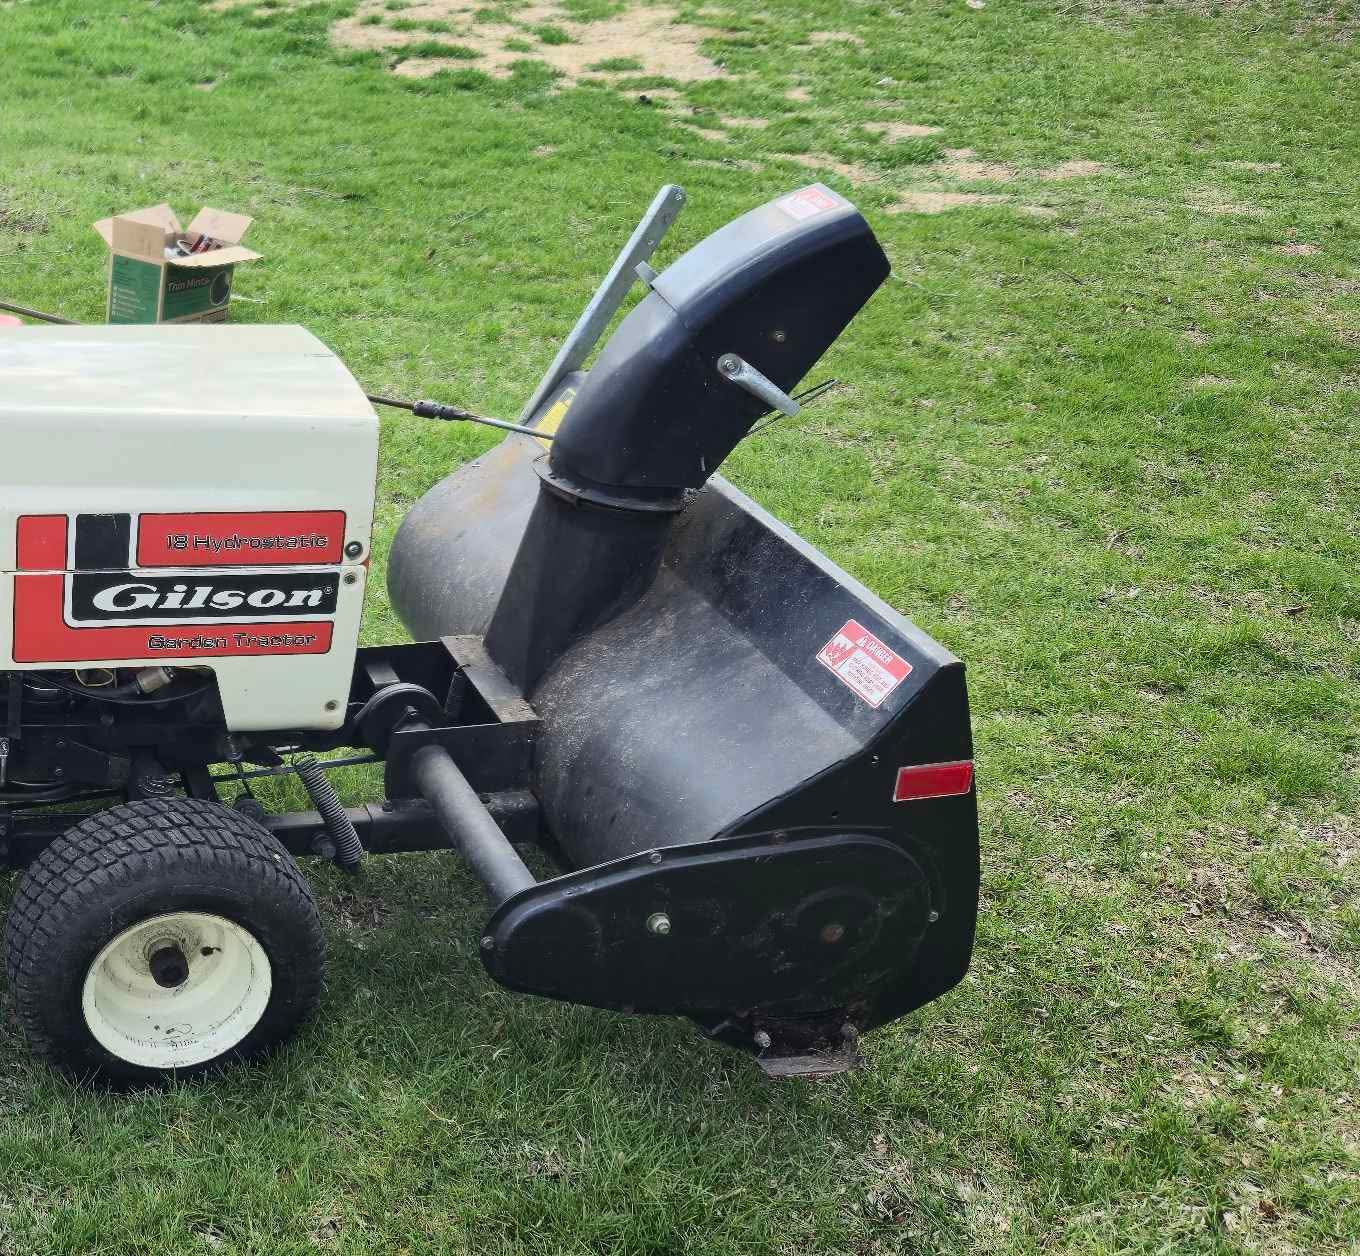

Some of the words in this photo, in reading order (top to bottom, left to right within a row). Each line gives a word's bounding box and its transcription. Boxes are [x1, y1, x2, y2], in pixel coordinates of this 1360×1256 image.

[167, 534, 188, 550] 18
[193, 533, 328, 552] Hydrostatic
[147, 634, 227, 650] Garden
[233, 633, 316, 649] Tractor
